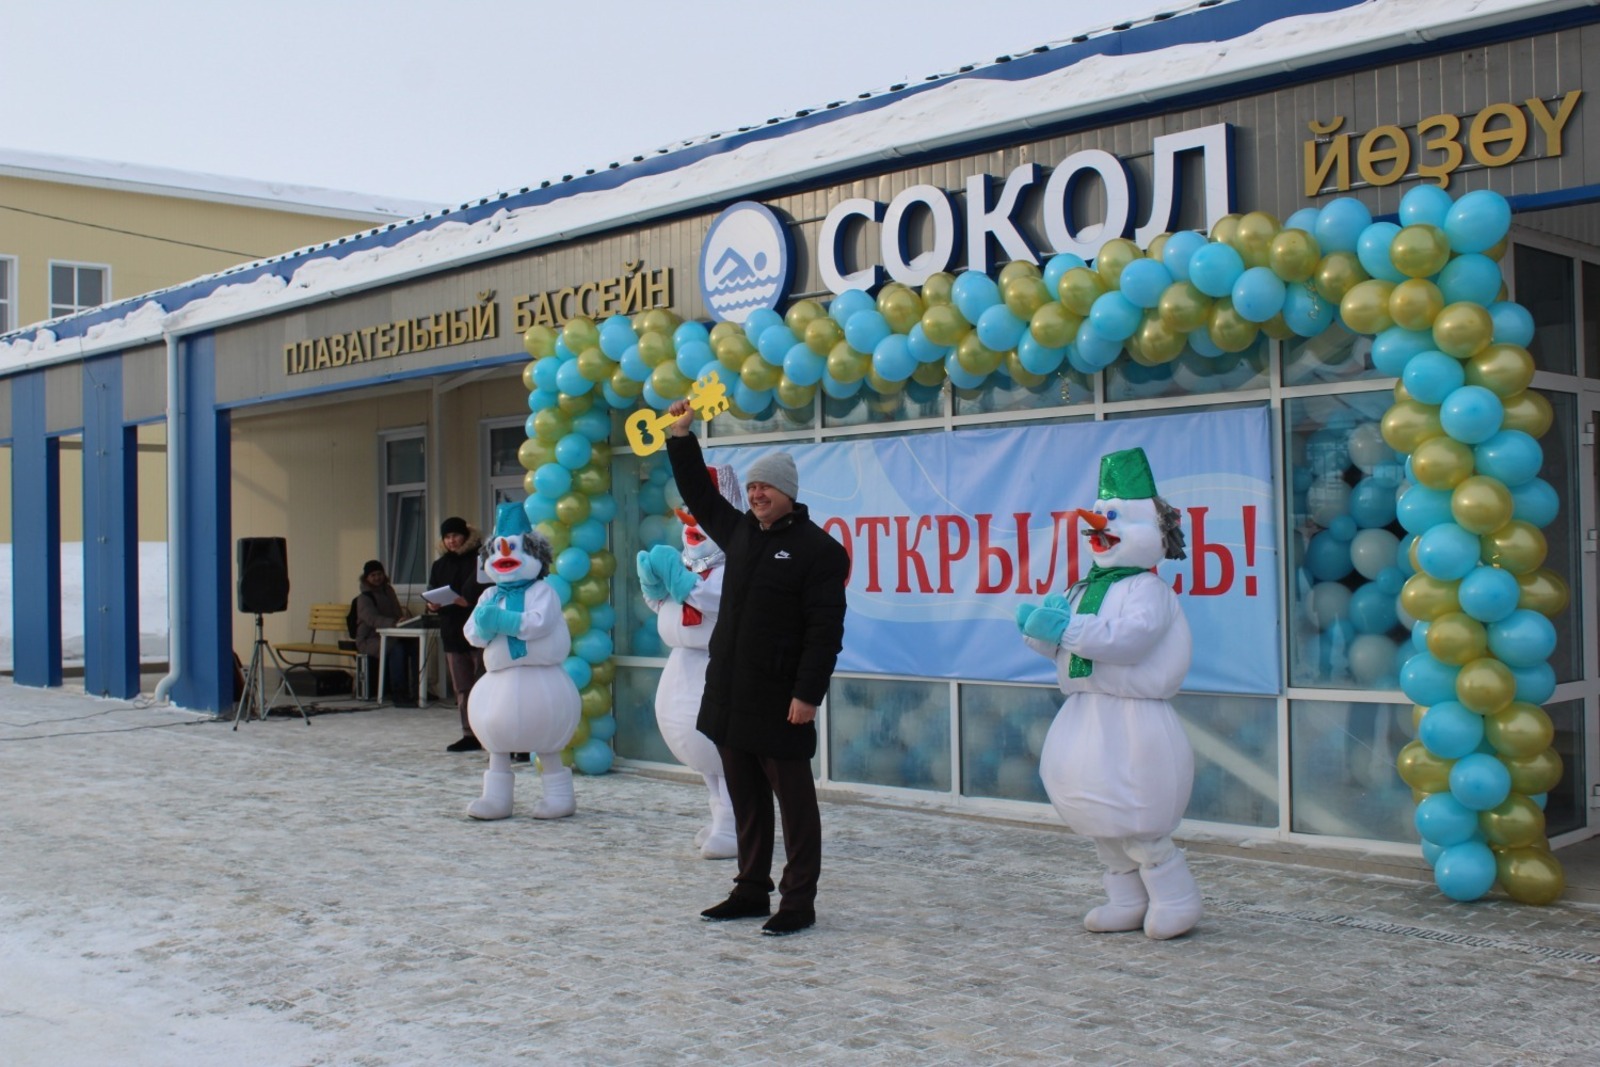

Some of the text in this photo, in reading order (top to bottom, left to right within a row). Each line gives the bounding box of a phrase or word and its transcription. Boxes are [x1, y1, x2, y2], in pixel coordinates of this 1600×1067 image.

[817, 122, 1236, 298] СОКОЛ
[282, 257, 674, 376] ПЛАВАТЕЛЬНЫЙ БАССЕЙН
[823, 505, 1258, 597] ОТКРЫЛЬ!
